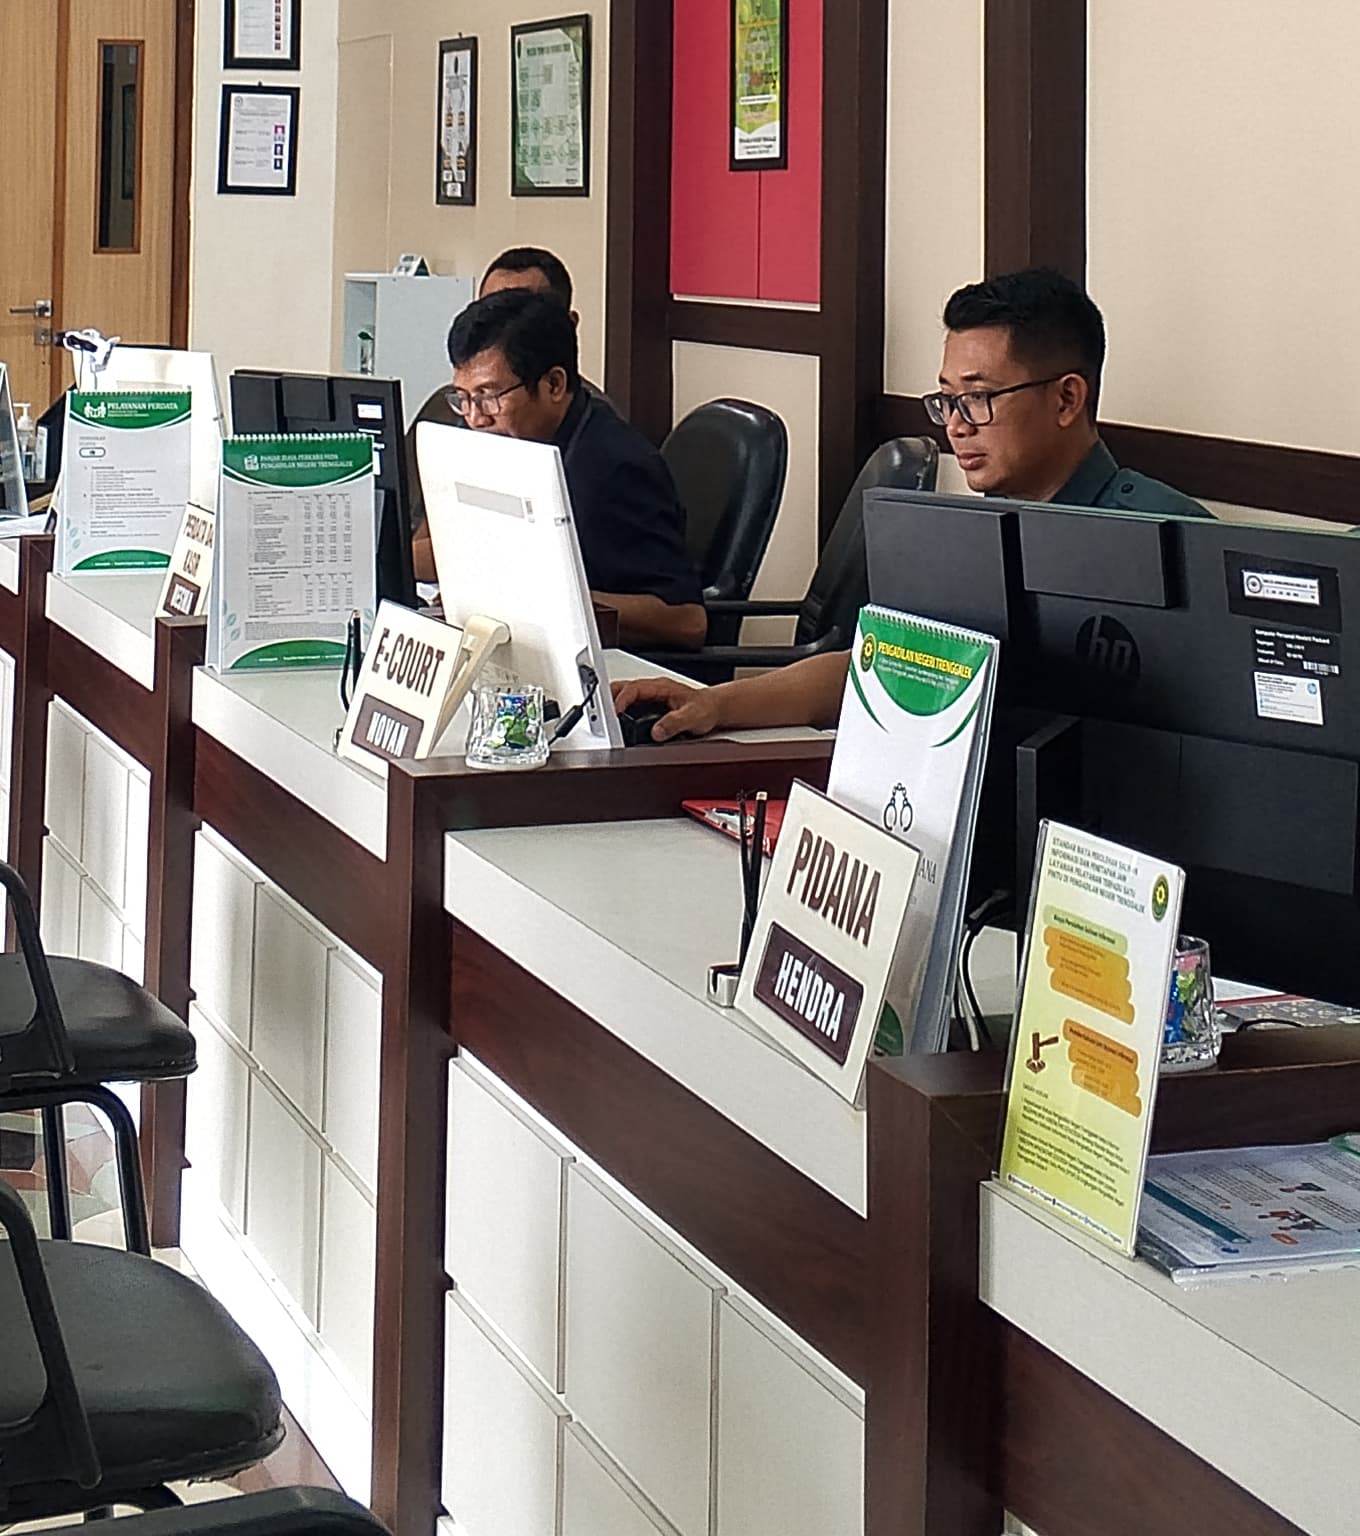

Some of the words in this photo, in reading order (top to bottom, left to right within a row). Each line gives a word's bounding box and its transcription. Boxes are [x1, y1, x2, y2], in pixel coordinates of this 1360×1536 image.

[148, 402, 178, 410] PERDATA
[372, 627, 445, 697] E-COURT
[878, 642, 915, 662] PENGADILAN
[915, 651, 935, 667] NEGERI
[936, 656, 973, 680] TRENGGALEK
[366, 711, 409, 758] NOVAN
[786, 827, 881, 948] PIDANA
[774, 951, 845, 1042] HENDRA
